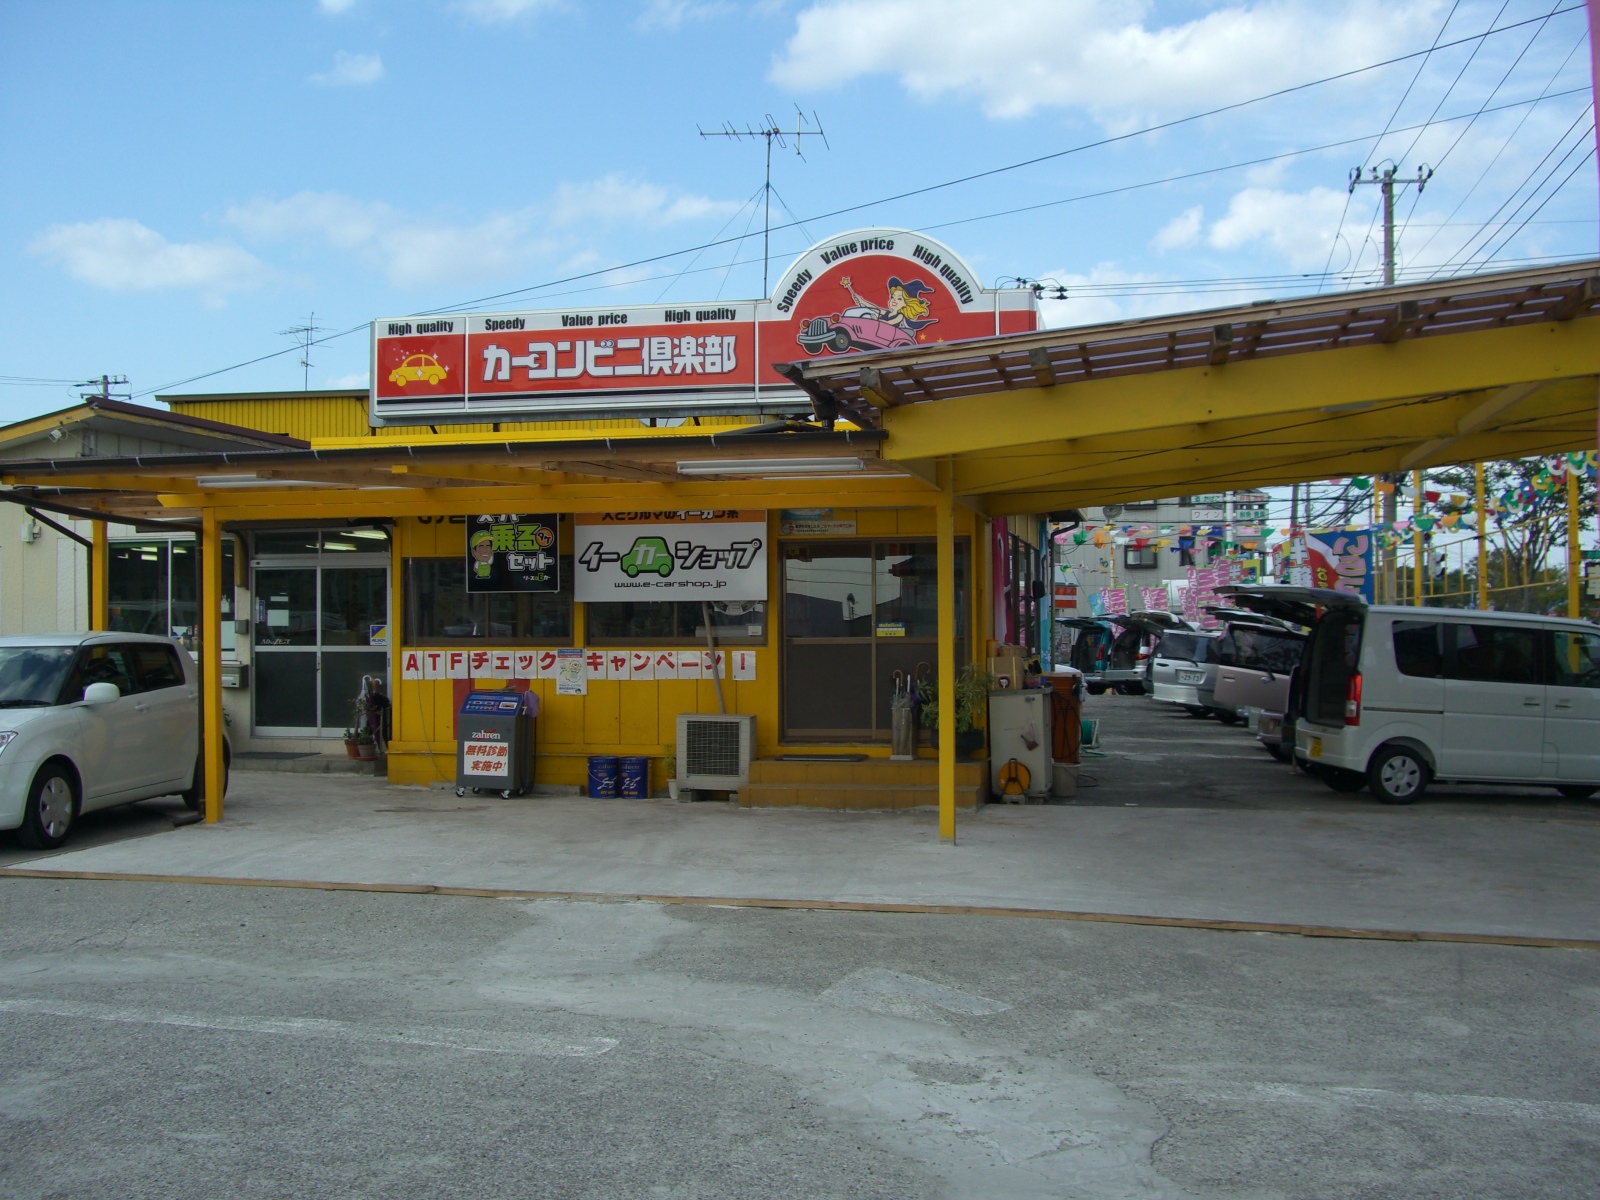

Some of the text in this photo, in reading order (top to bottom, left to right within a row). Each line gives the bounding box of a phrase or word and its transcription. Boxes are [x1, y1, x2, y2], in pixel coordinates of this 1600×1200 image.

[776, 237, 974, 313] Speedy Value price High quality
[387, 320, 454, 336] High quality
[484, 307, 737, 332] Speedy Value price High quality
[482, 334, 738, 383] カーコンビニ倶楽部
[1194, 511, 1221, 519] ワイン
[490, 523, 542, 552] 乗る
[507, 552, 555, 572] セット
[614, 579, 727, 589] www.e-carshop.jp
[405, 652, 557, 672] ATFチェック
[471, 729, 501, 740] zahren
[465, 745, 508, 757] 無料診断
